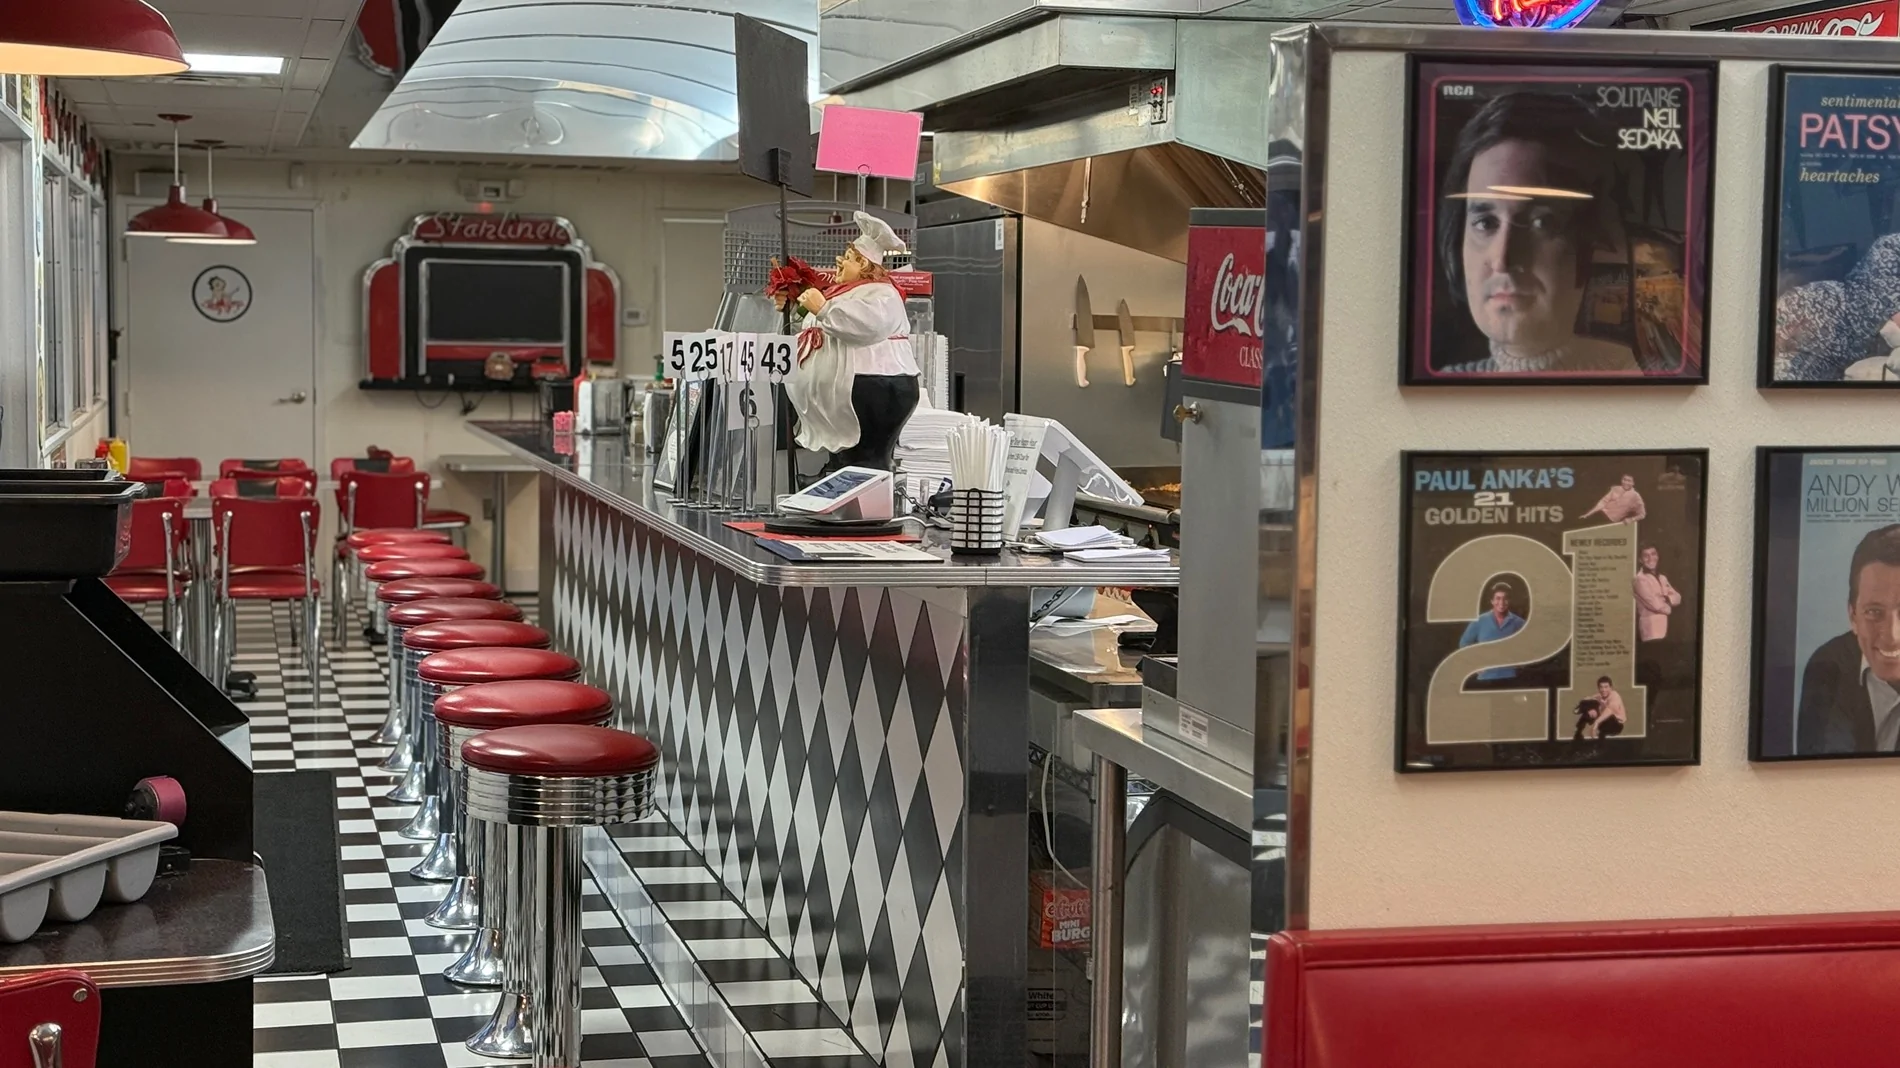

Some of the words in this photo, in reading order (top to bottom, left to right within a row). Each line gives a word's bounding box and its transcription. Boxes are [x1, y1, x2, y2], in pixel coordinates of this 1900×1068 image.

[1781, 19, 1822, 35] DRINK
[1443, 85, 1474, 96] RCA
[1597, 86, 1681, 108] SOLITAIRE
[1643, 108, 1681, 129] NEIL
[1617, 128, 1682, 149] SEDAKA
[1799, 166, 1880, 183] heartaches
[421, 210, 568, 241] Starliner
[689, 338, 718, 373] 25
[719, 341, 734, 376] 17
[740, 340, 755, 374] 45
[761, 342, 792, 376] 43
[739, 388, 757, 419] 6
[1414, 469, 1476, 491] PAUL
[1481, 467, 1575, 490] ANKA'S
[1807, 473, 1877, 497] ANDY
[1473, 491, 1514, 507] 21
[1806, 497, 1869, 513] MILLION
[1424, 507, 1509, 526] GOLDEN
[1516, 505, 1564, 524] HITS
[1059, 919, 1080, 929] MINI
